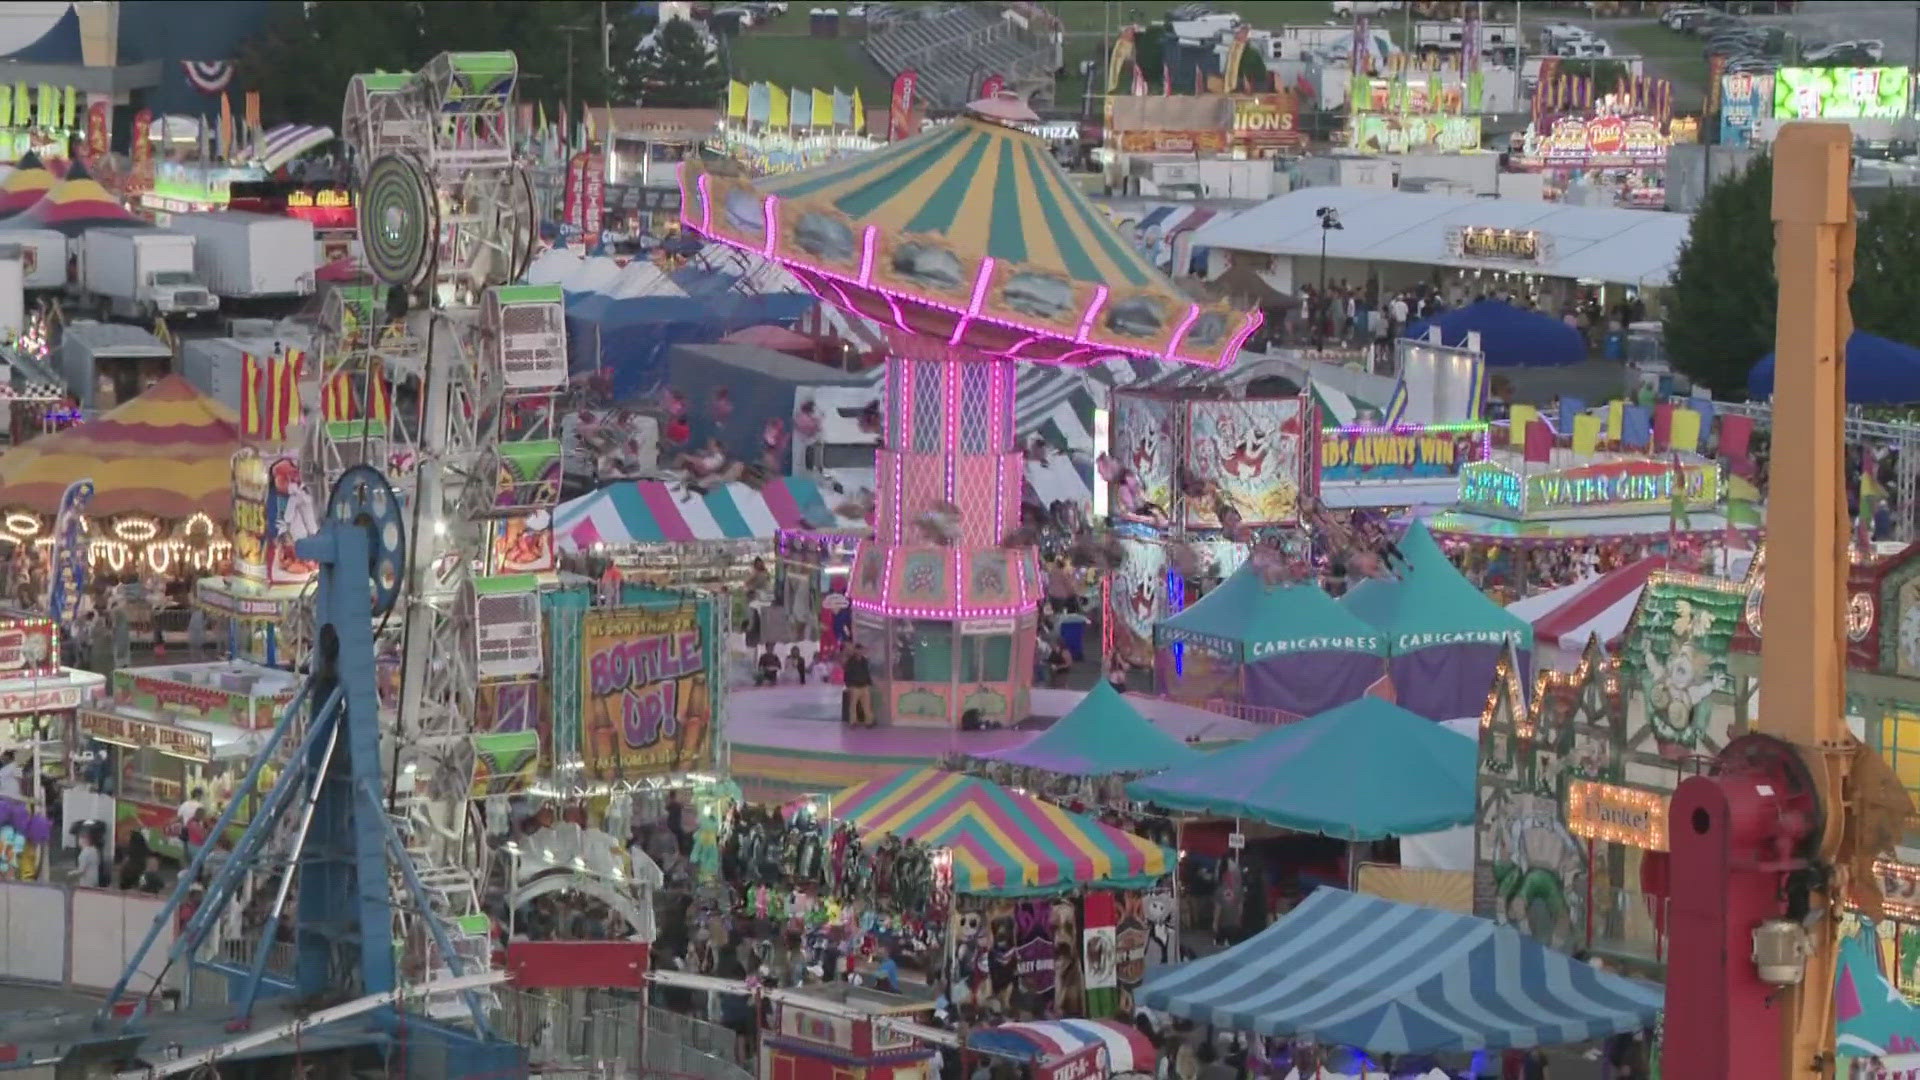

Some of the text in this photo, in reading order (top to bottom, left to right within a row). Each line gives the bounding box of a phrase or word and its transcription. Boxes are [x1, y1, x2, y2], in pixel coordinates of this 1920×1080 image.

[1042, 125, 1079, 140] PIZZA
[1321, 436, 1455, 467] IDS ALWAYS WIN
[1540, 474, 1609, 505] WATER
[1615, 469, 1658, 500] GUN
[1252, 636, 1378, 657] CARICATURES
[1399, 629, 1522, 650] CARICATURES
[591, 631, 704, 695] BOTTLE
[622, 679, 677, 748] UP!
[1584, 795, 1649, 832] Danke!
